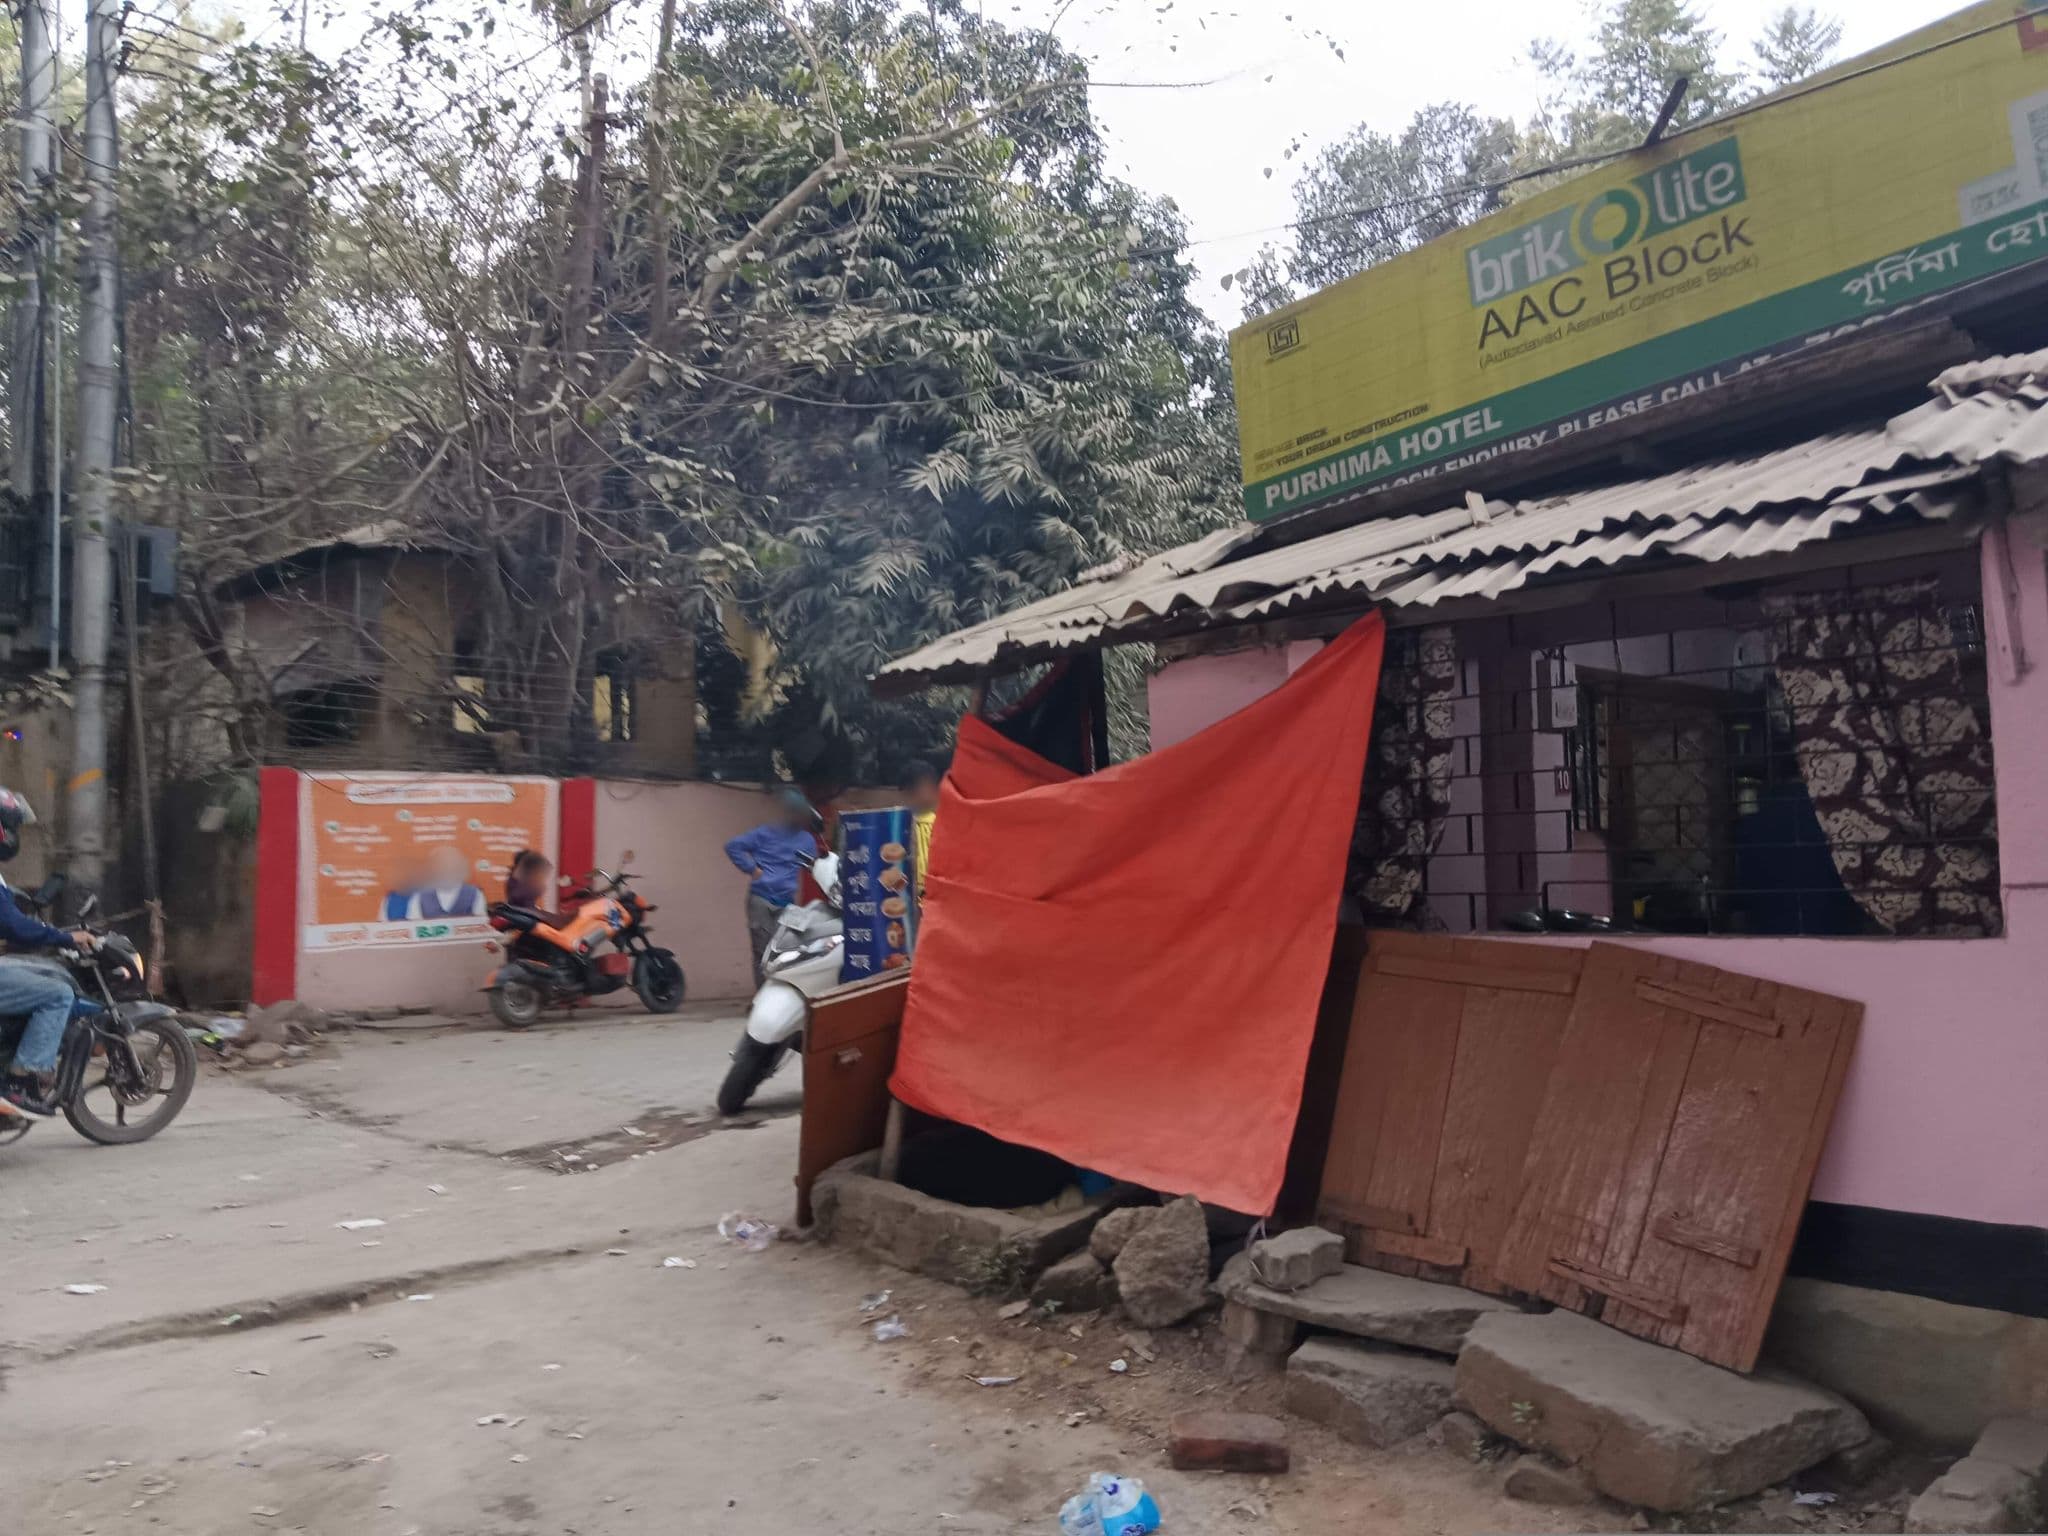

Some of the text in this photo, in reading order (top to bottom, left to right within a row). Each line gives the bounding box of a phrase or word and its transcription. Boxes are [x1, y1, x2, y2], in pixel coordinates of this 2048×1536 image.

[1987, 212, 2048, 252] হো
[1478, 277, 1586, 349] AAC
[1629, 275, 1703, 313] Concrete
[1343, 403, 1429, 442] CONSTRUCTION
[1558, 394, 1652, 439] PLEASE
[1661, 371, 1722, 400] CALL
[1264, 446, 1392, 508] PURNIMA
[1400, 406, 1502, 460] HOTEL
[1556, 770, 1570, 790] 10
